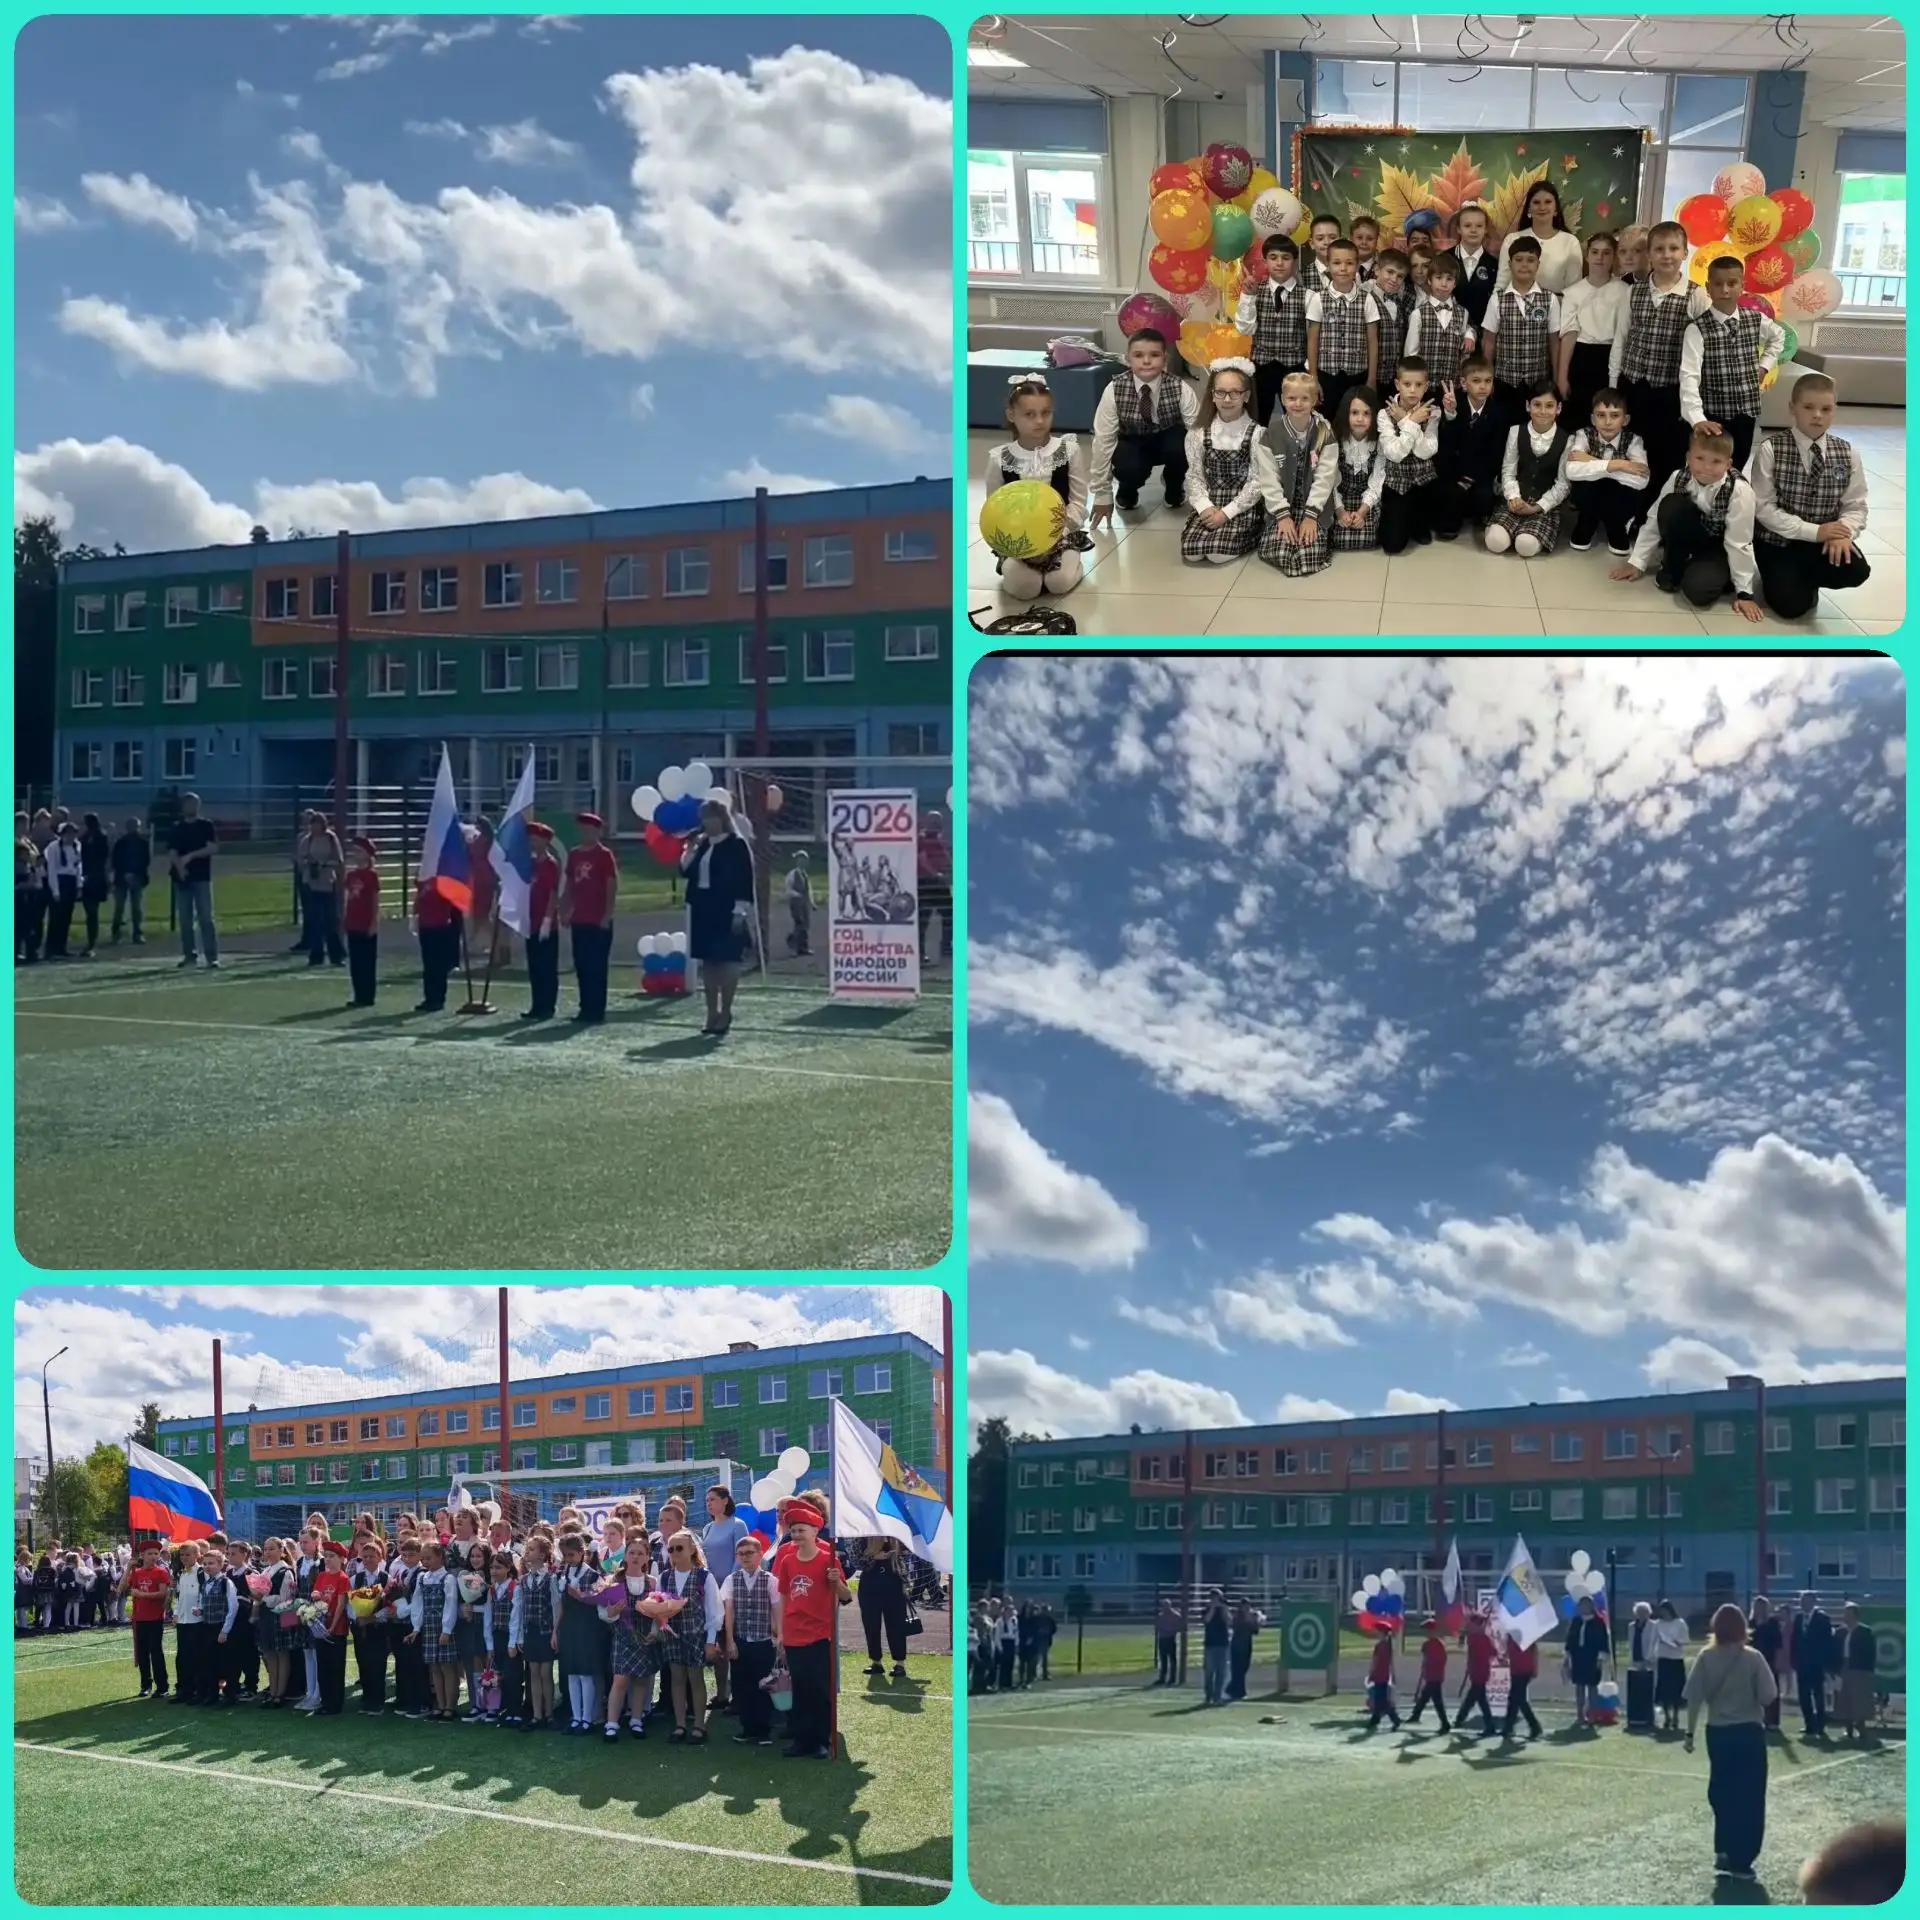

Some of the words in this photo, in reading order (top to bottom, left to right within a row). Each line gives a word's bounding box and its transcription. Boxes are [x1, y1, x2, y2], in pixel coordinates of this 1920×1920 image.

[832, 803, 913, 833] 2026
[834, 929, 863, 941] ГОД
[834, 942, 914, 955] ЕДИНСТВА
[834, 957, 907, 969] НАРОДОВ
[834, 971, 898, 983] РОССИИ
